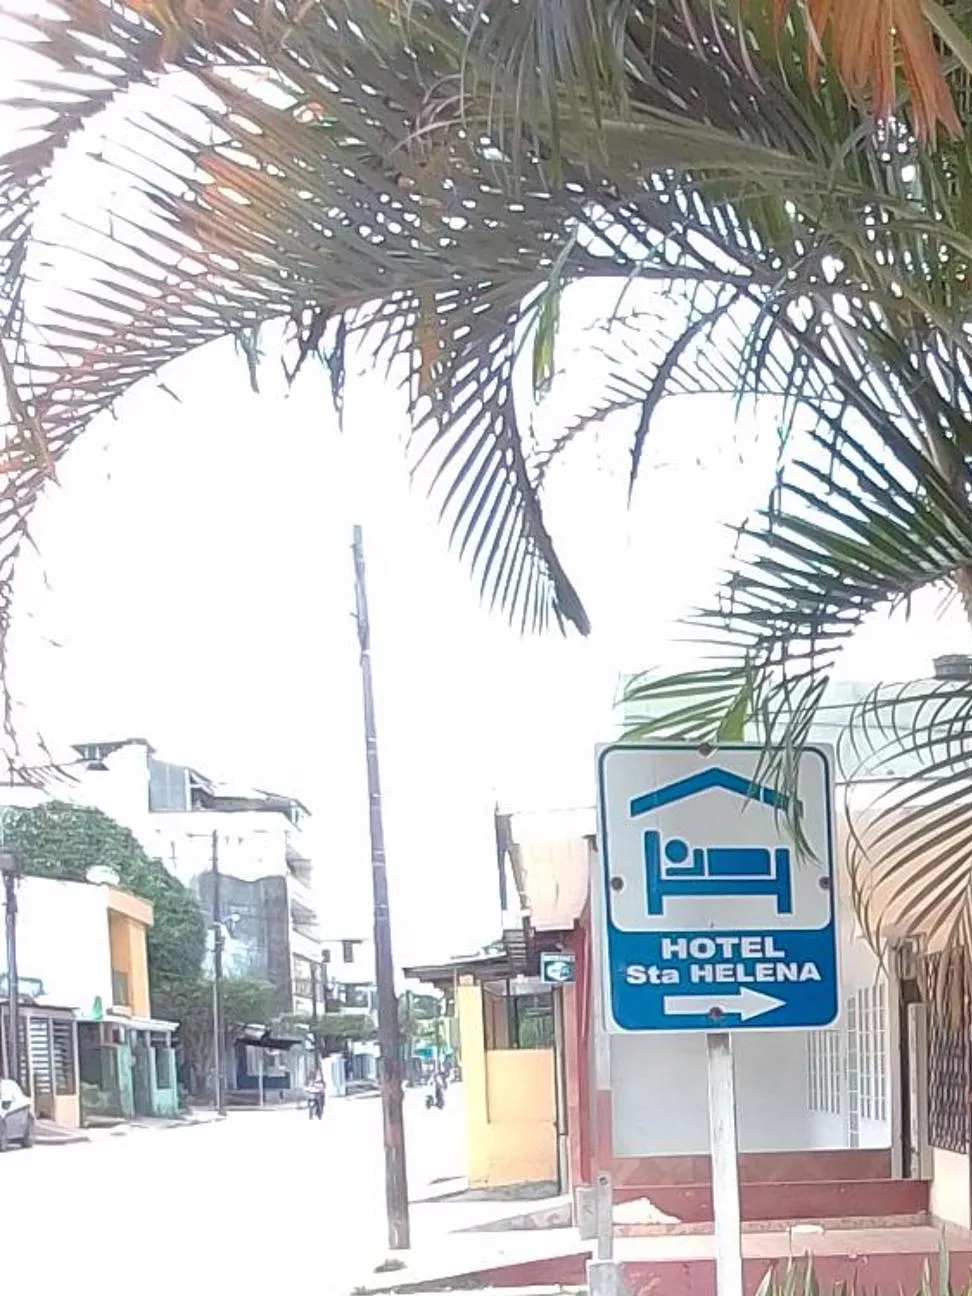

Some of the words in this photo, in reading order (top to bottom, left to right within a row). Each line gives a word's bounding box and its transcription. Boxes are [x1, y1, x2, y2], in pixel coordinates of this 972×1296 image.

[661, 936, 785, 960] HOTEL
[626, 965, 679, 985] Sta
[690, 962, 821, 983] HELENA
